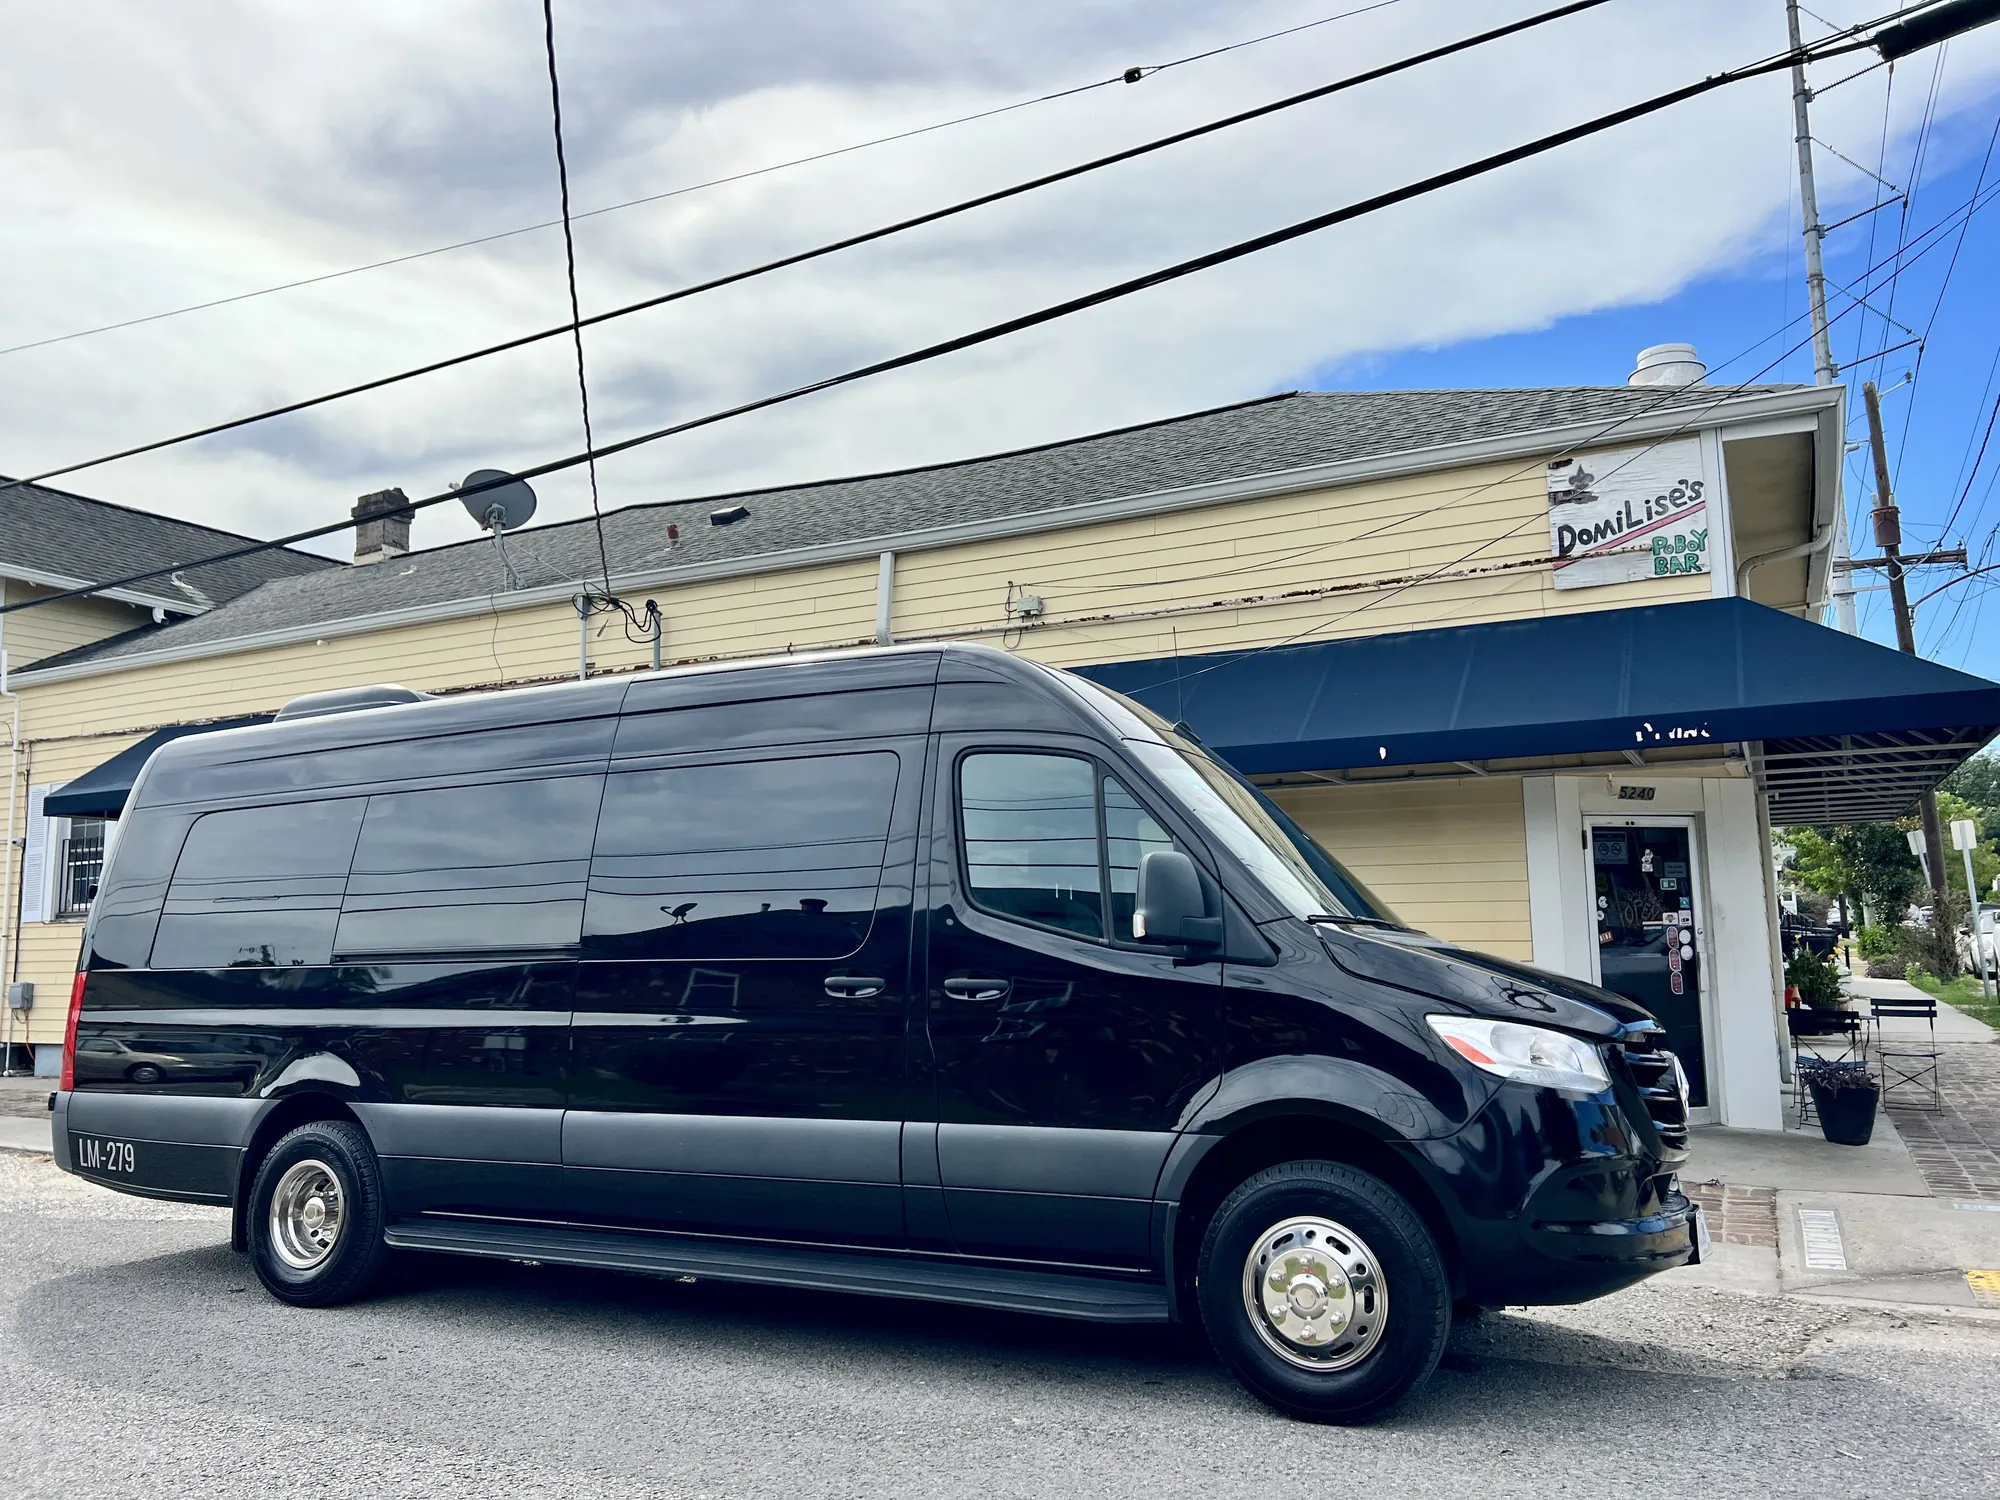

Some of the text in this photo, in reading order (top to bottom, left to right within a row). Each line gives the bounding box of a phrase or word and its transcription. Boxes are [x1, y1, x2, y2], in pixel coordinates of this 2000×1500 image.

[1654, 553, 1702, 575] BAR
[1619, 786, 1655, 800] 5240
[79, 1138, 135, 1173] LM-279
